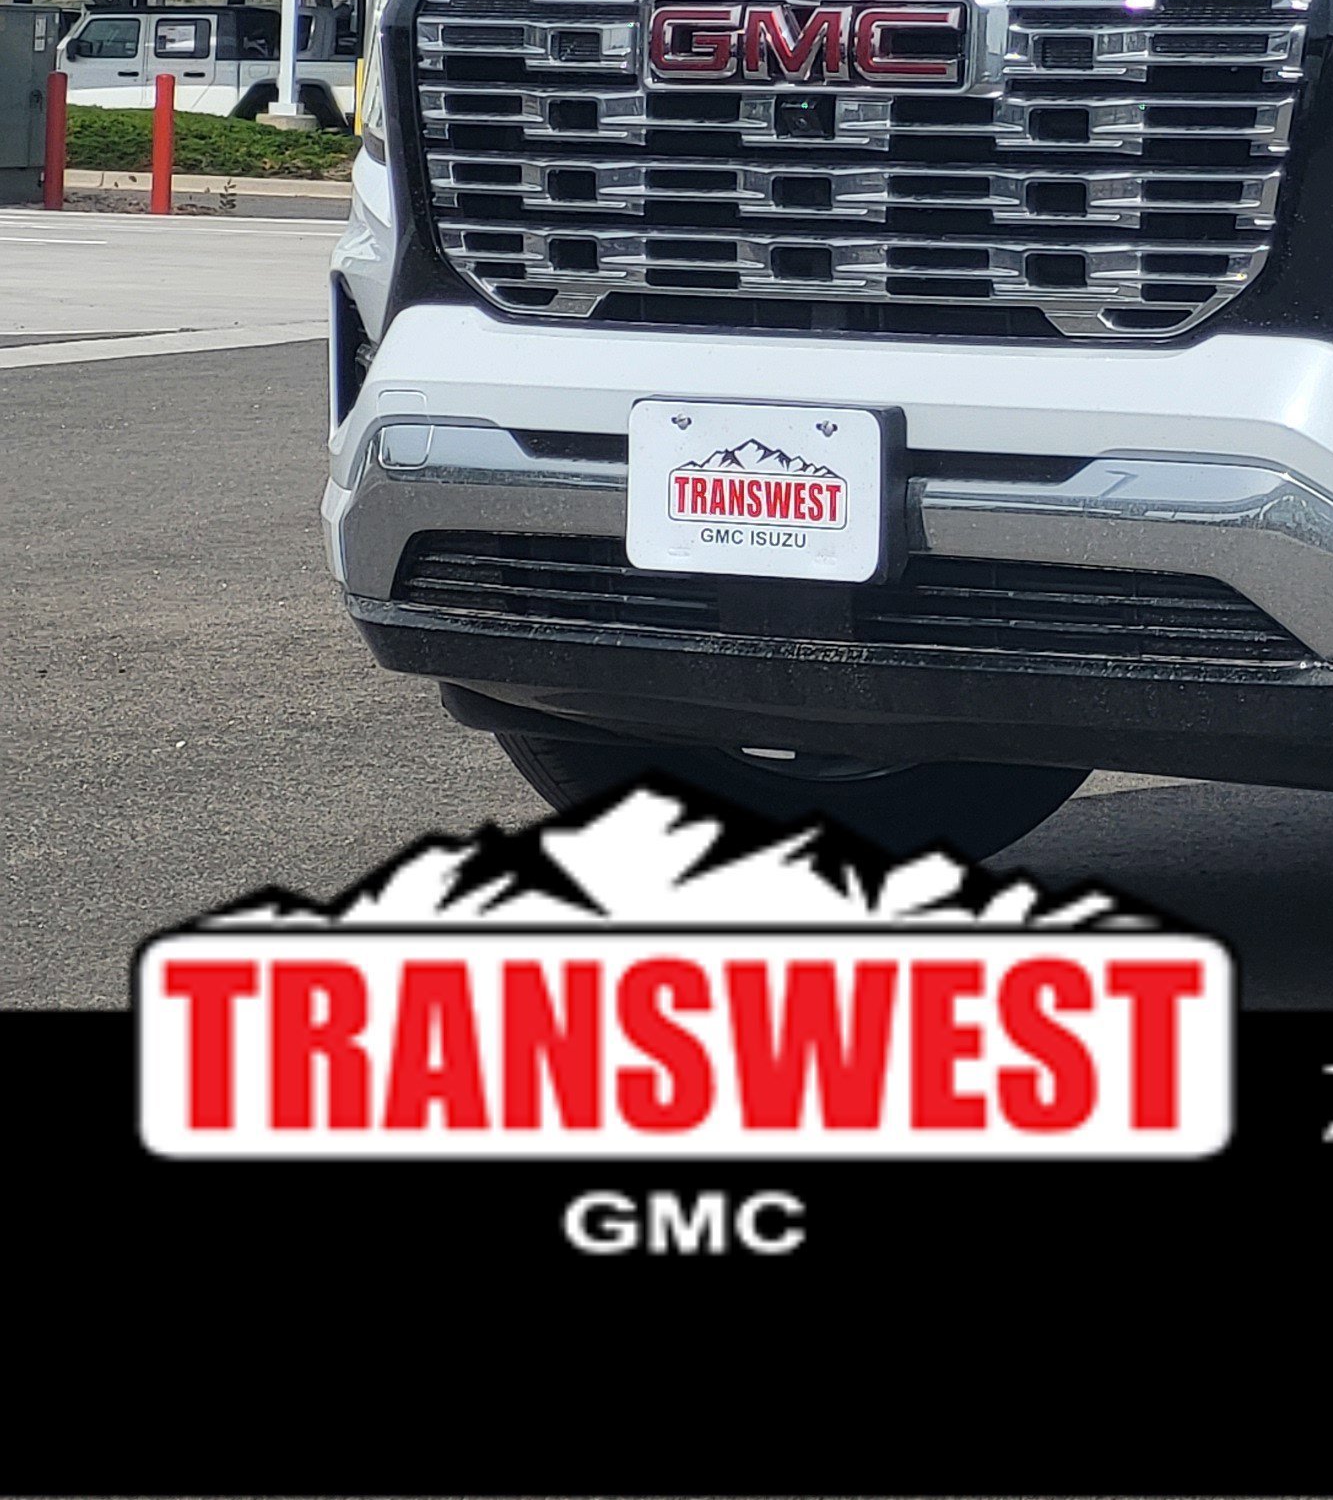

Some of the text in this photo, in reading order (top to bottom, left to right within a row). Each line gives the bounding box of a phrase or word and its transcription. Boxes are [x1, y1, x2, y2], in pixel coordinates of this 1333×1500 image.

[650, 4, 963, 82] GMC
[674, 476, 842, 522] TRANSWEST
[700, 528, 807, 548] GMC ISUZU
